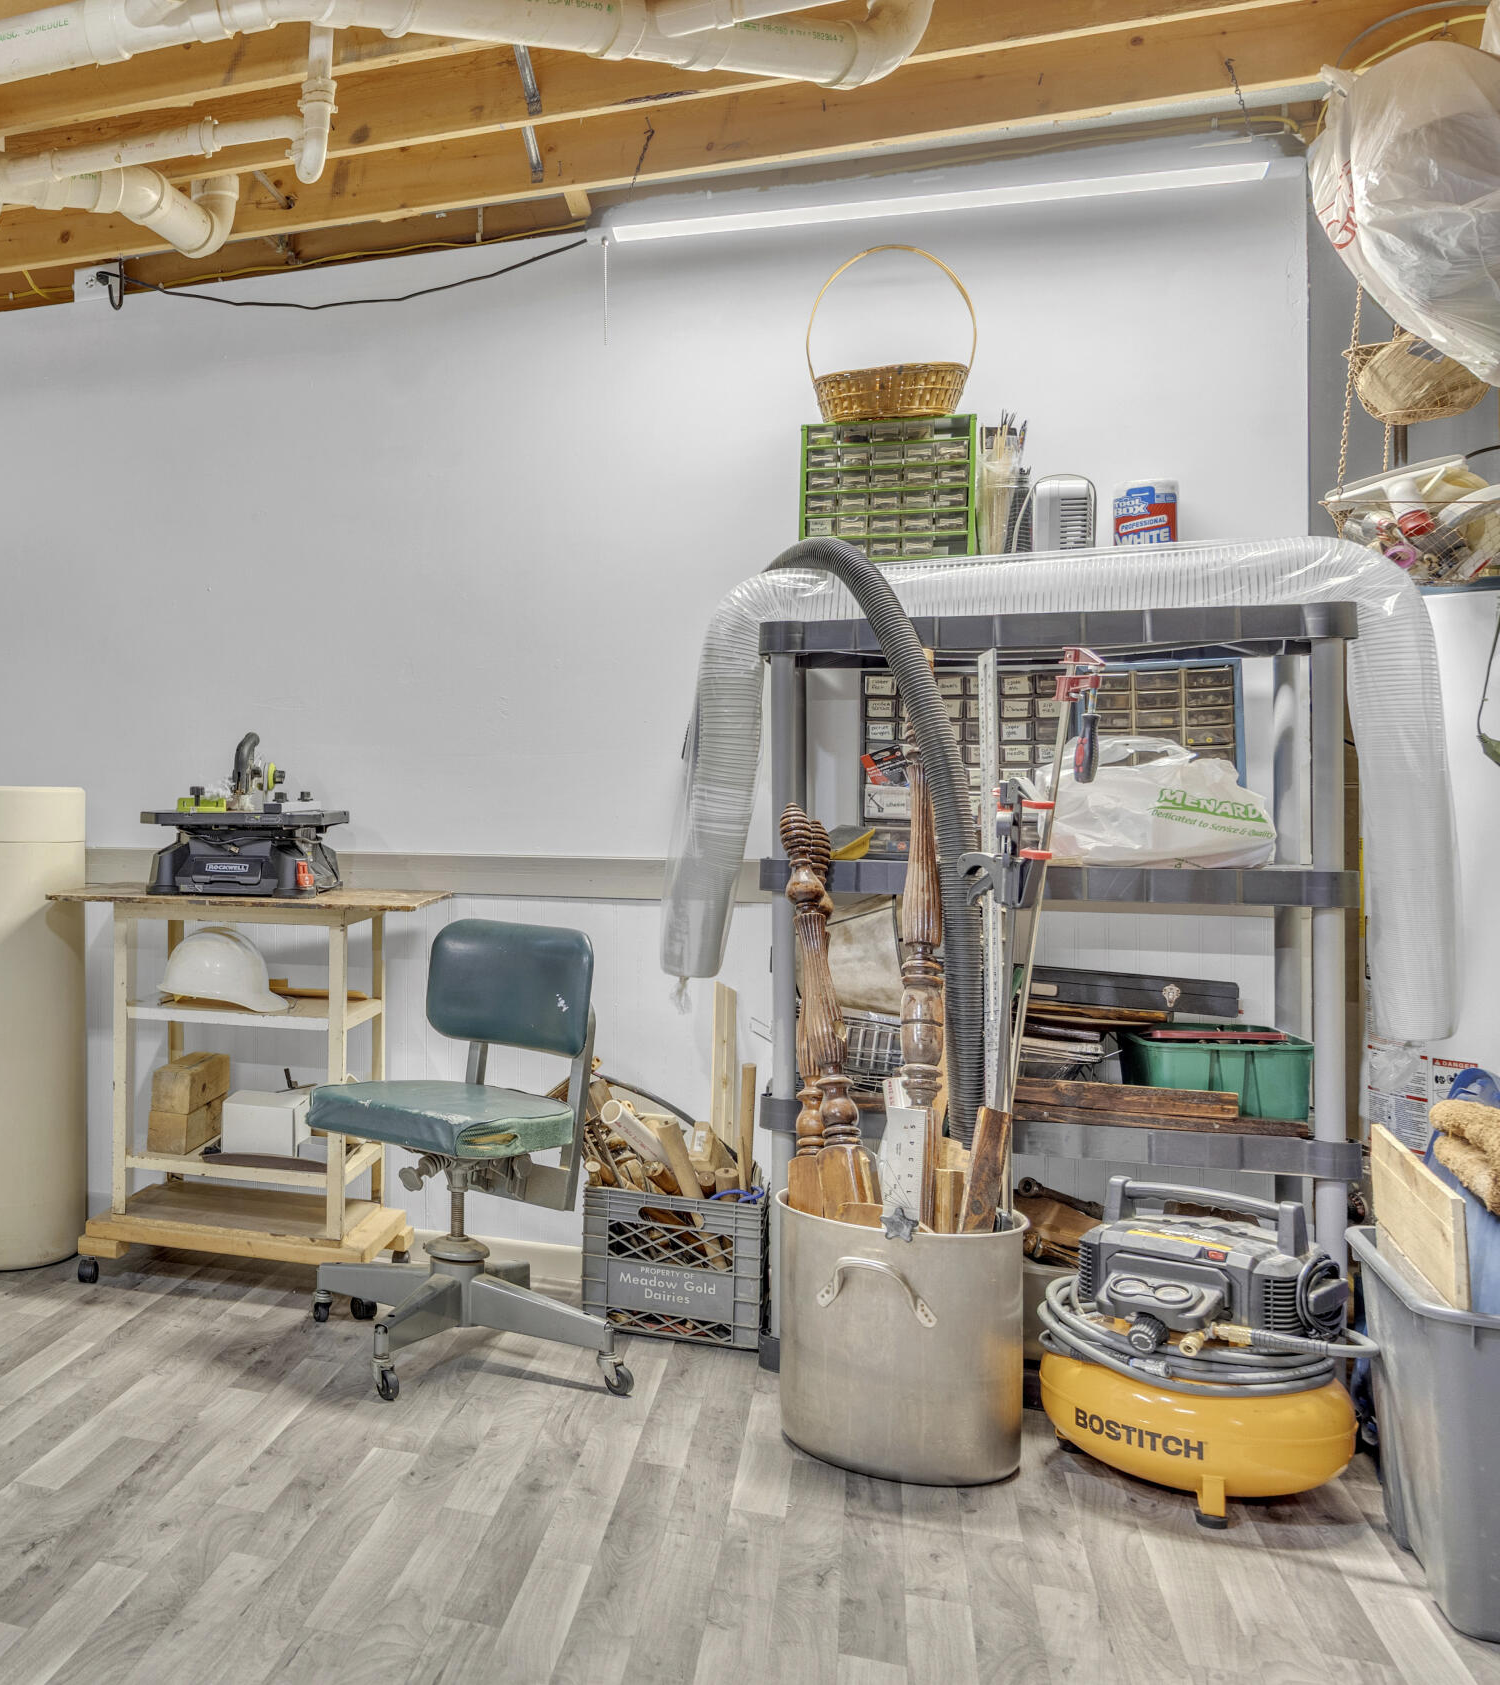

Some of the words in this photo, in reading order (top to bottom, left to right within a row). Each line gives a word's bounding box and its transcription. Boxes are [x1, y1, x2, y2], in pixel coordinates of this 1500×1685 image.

[1115, 503, 1149, 516] BOX
[1120, 516, 1166, 532] PROFESSIONAL
[1114, 527, 1170, 546] WHITE
[1157, 788, 1263, 819] MENARD
[1151, 809, 1198, 825] Dedicated
[1198, 819, 1209, 829] to
[1209, 824, 1240, 835] Service
[1240, 828, 1247, 836] &
[1247, 829, 1275, 839] Quality
[207, 864, 248, 873] ROCKWELL
[1442, 1061, 1475, 1069] DANGER
[640, 1266, 680, 1278] PROPERTY
[683, 1272, 697, 1280] OF
[619, 1271, 678, 1290] Meadow
[684, 1280, 716, 1295] Gold
[644, 1288, 691, 1304] Dairies
[1075, 1407, 1204, 1460] BOSTITCH
